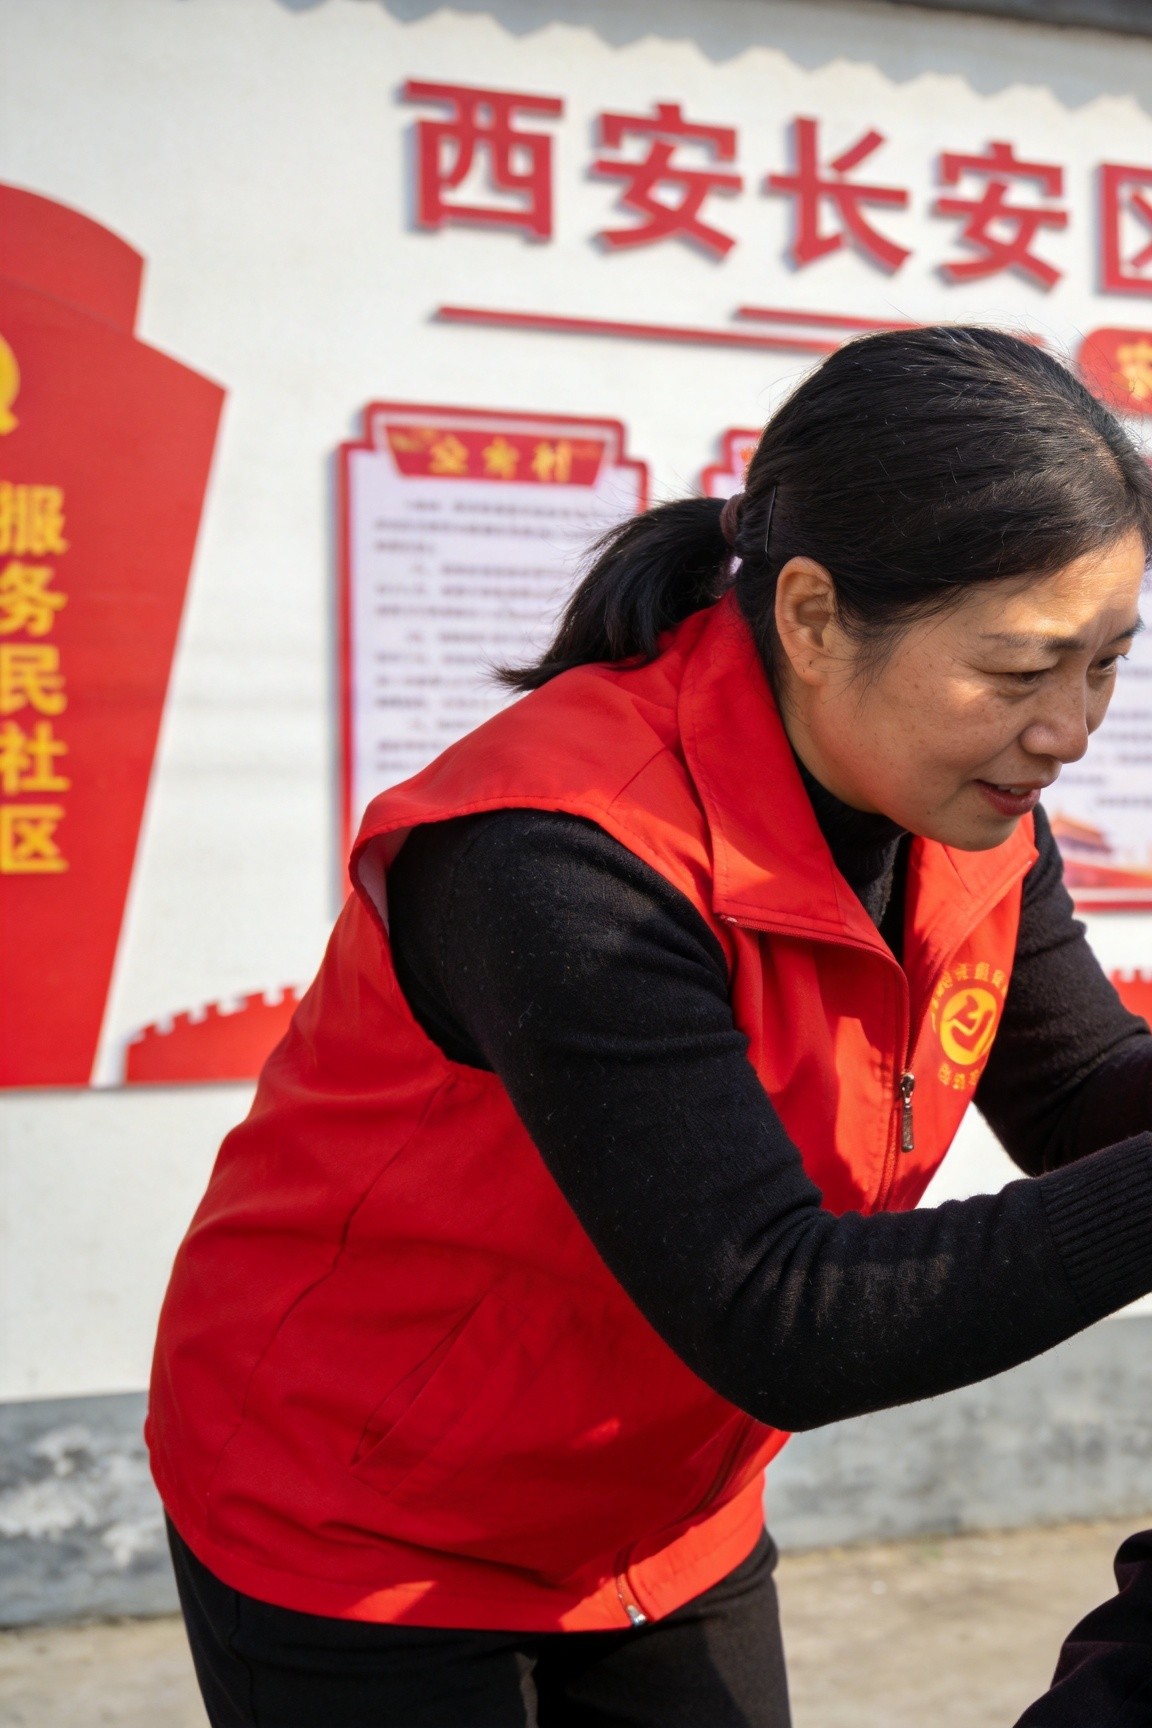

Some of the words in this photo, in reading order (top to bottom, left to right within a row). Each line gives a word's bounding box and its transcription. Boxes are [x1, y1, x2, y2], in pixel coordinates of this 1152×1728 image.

[0, 480, 70, 874] 服务民社区
